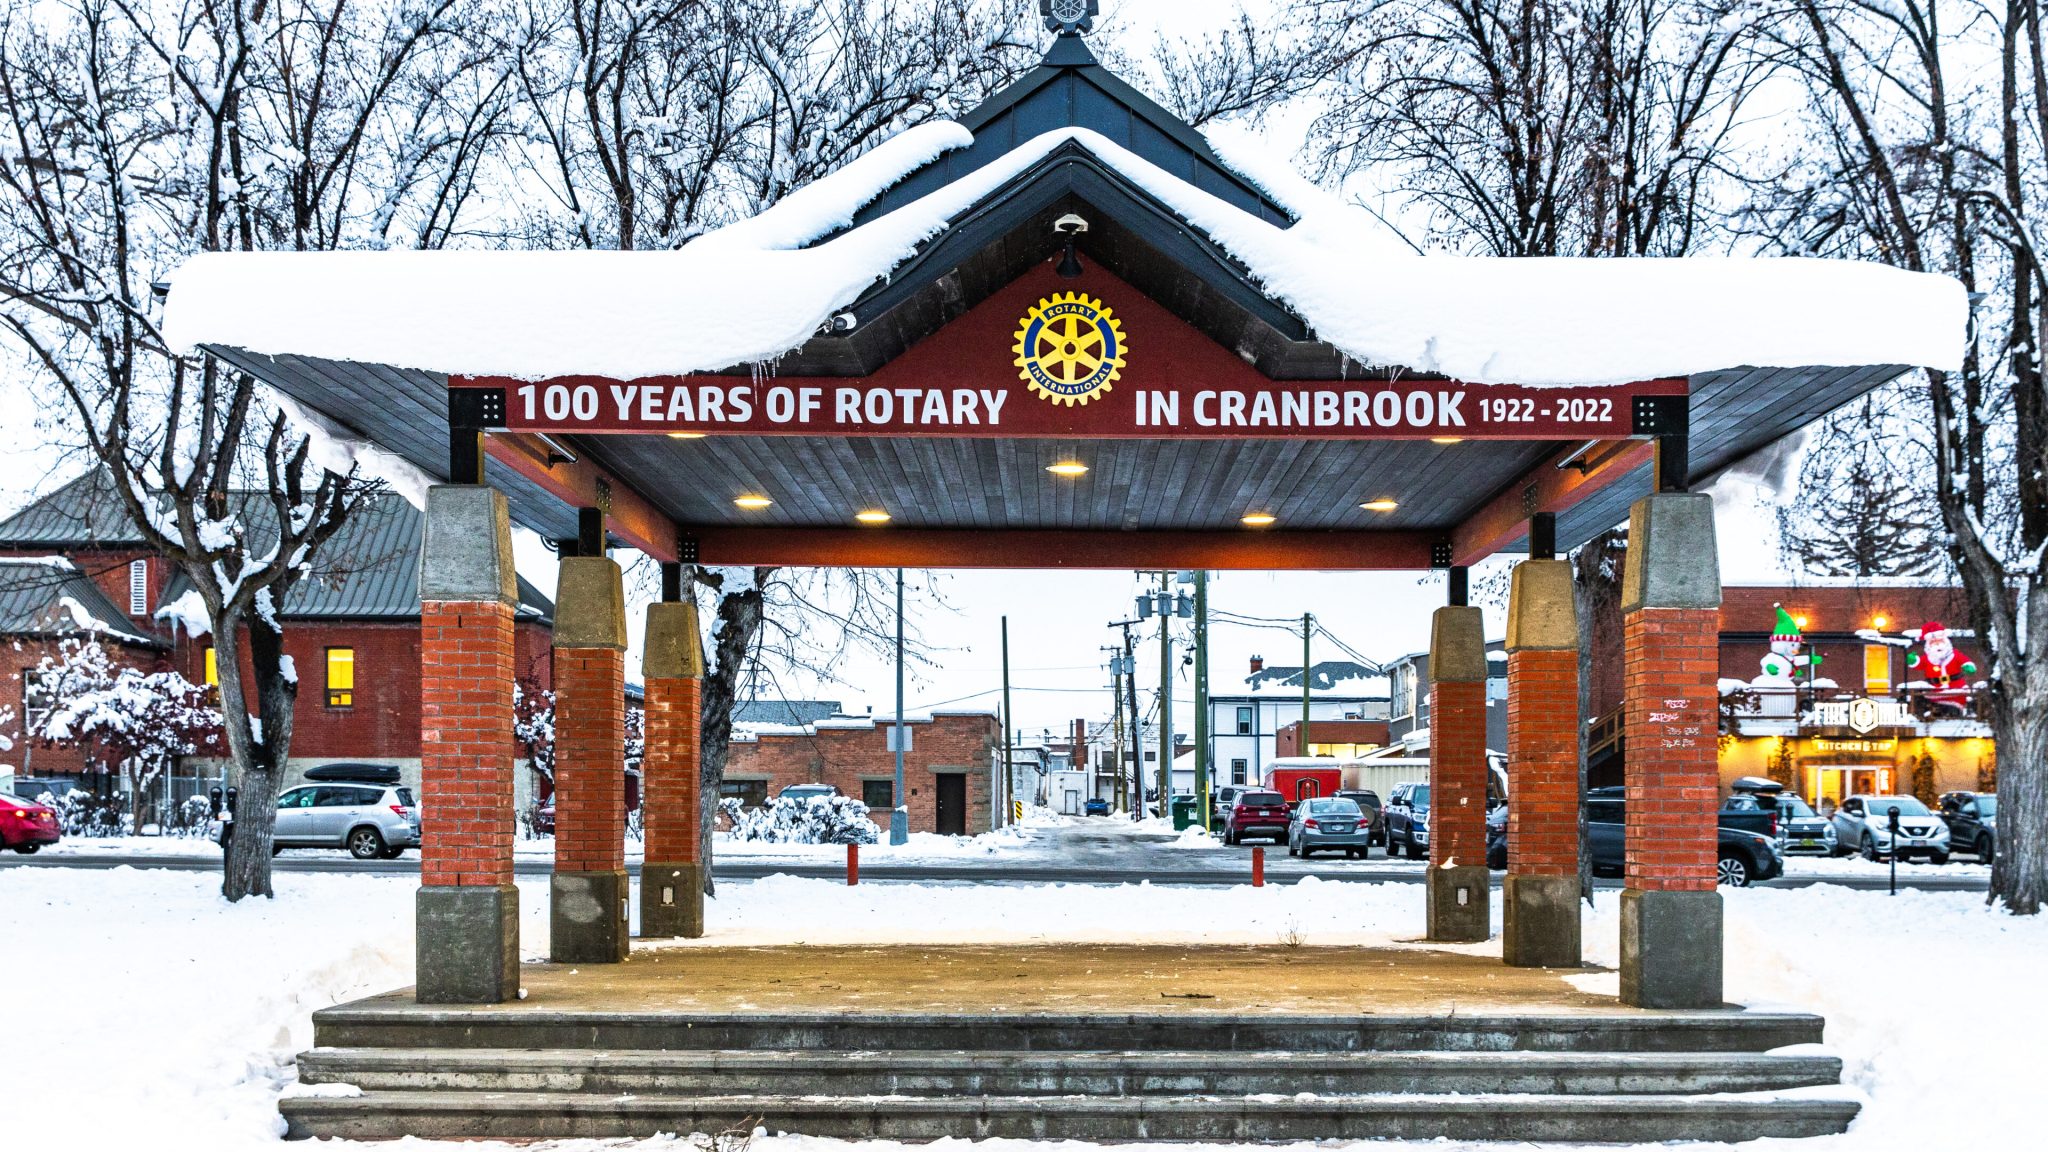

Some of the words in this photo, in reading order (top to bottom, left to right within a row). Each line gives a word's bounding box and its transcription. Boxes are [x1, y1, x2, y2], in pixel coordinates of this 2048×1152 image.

[1047, 305, 1093, 317] ROTARY
[1030, 365, 1110, 394] INTERNATIONAL
[517, 384, 599, 421] 100
[609, 385, 753, 423] YEARS
[765, 386, 823, 423] OF
[835, 387, 1008, 425] ROTARY
[1135, 390, 1179, 426] IN
[1193, 390, 1467, 427] CRANBROOK
[1479, 398, 1535, 422] 1922
[1556, 398, 1613, 423] 2022
